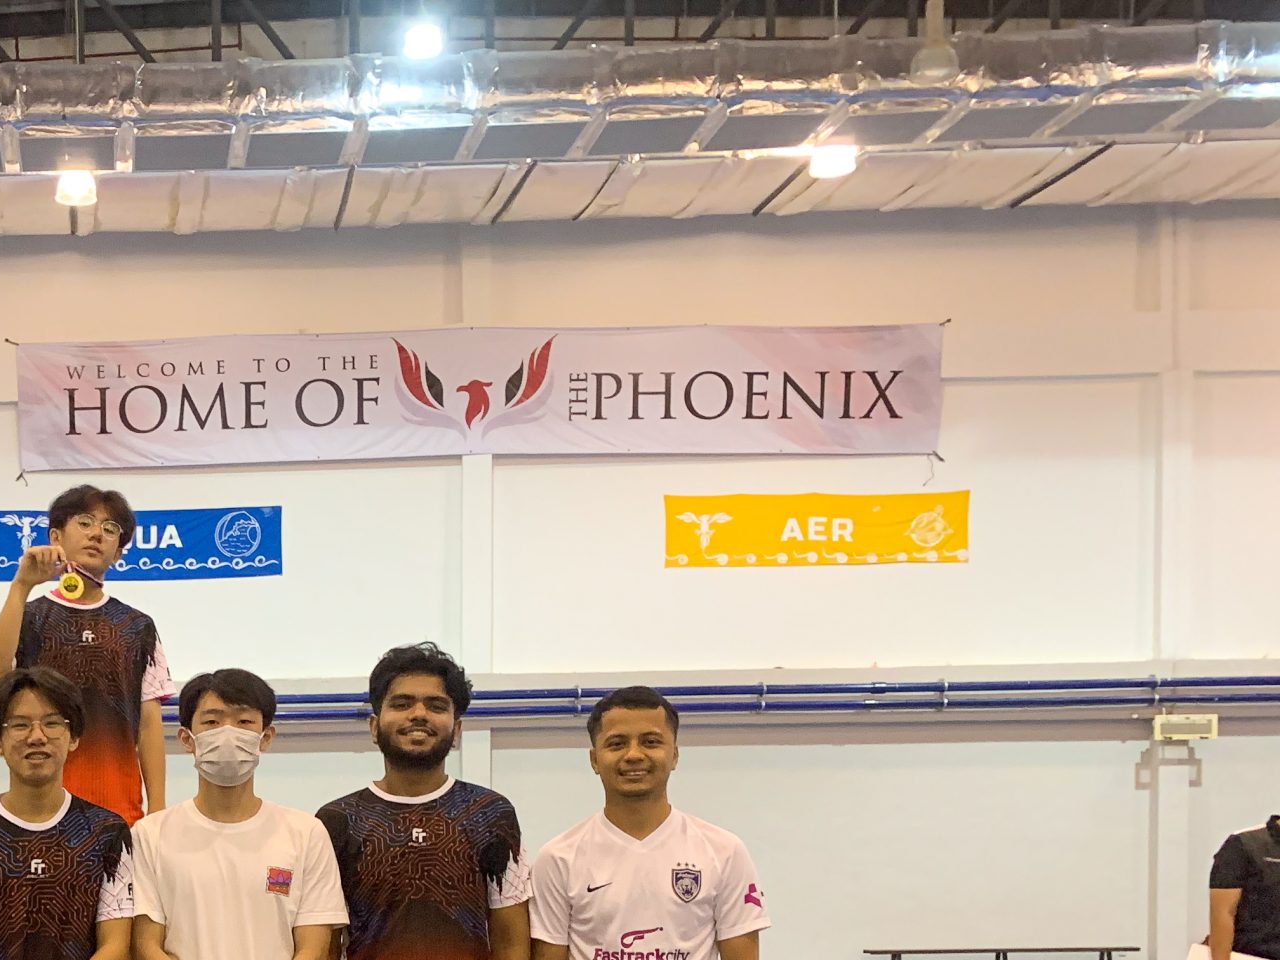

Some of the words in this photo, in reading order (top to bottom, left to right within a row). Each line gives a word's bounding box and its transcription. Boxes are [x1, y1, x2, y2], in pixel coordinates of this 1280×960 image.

[66, 359, 227, 381] WELCOME
[253, 357, 291, 374] TO
[317, 354, 379, 372] THE
[63, 381, 269, 436] HOME
[294, 376, 381, 428] OF
[568, 371, 589, 422] THE
[591, 369, 905, 421] PHOENIX
[122, 523, 184, 554] UA
[780, 516, 855, 543] AER
